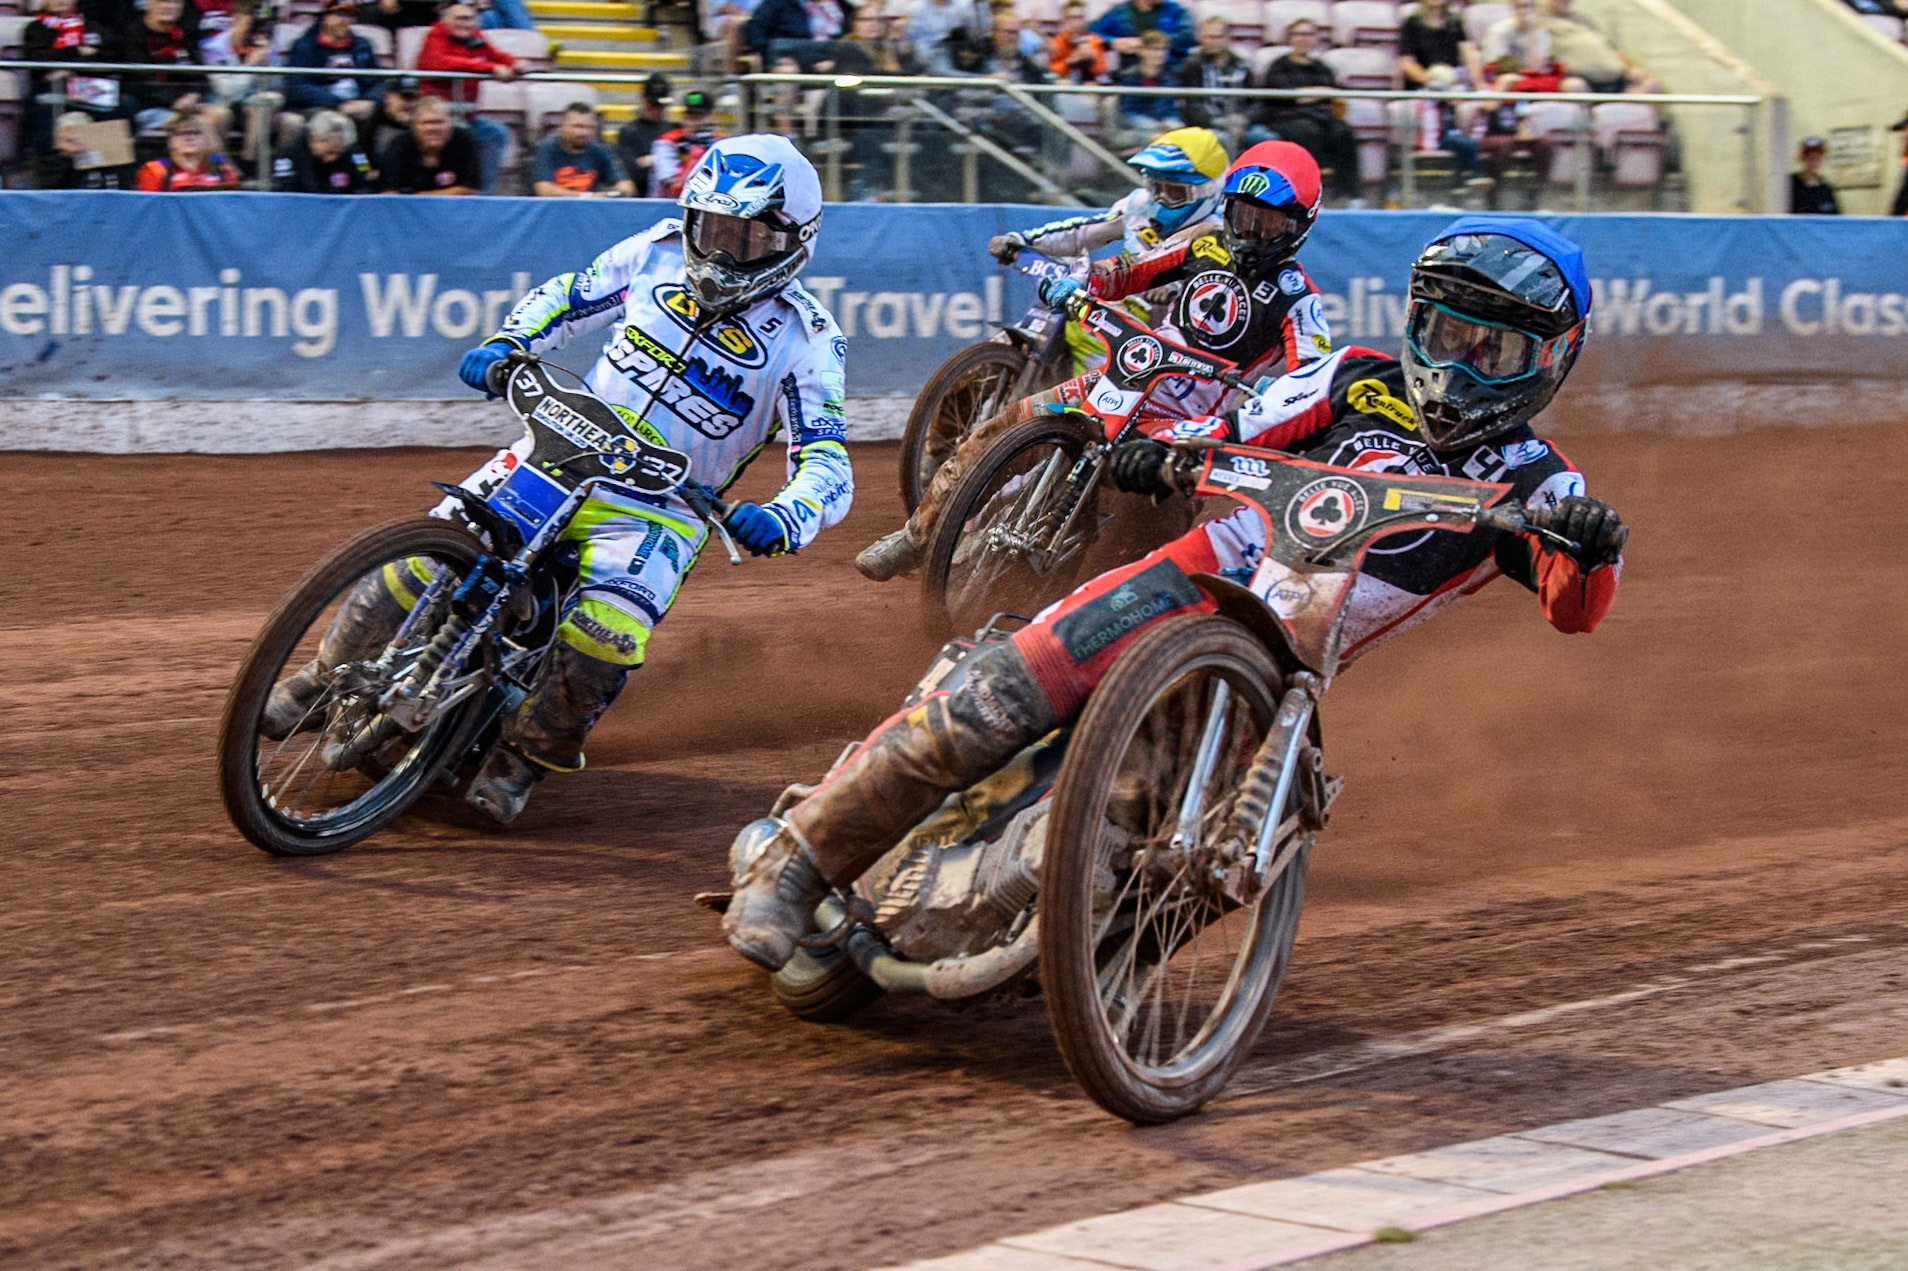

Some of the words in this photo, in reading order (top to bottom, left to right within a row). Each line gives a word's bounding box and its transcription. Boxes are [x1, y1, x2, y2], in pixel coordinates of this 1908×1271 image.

[760, 318, 783, 334] 5
[804, 276, 1004, 339] Travel
[1588, 277, 1763, 336] World
[515, 370, 544, 397] 37
[607, 338, 742, 438] SPARES
[1353, 436, 1401, 451] BELLE
[1299, 482, 1328, 503] BELLE
[1330, 481, 1352, 493] VUE
[1071, 591, 1173, 659] THERMOHOME
